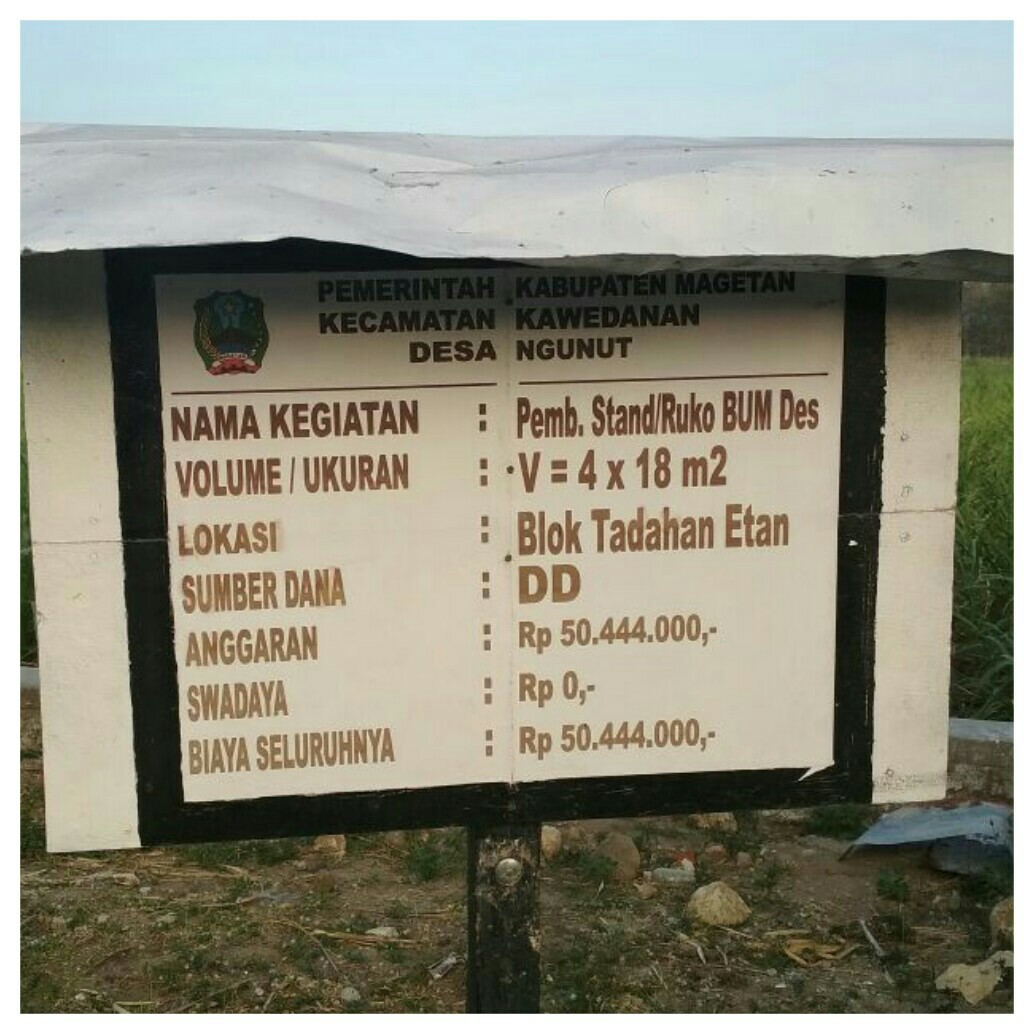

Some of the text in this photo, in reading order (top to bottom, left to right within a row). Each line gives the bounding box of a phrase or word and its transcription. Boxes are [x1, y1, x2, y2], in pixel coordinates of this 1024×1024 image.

[318, 271, 796, 302] PEMERINTAH KABUPATEN MAGETAN
[319, 303, 700, 334] KECAMATAN KAWEDANAN
[409, 337, 633, 363] DESA NGUNUT
[170, 404, 261, 441] NAMA
[269, 400, 419, 439] KEGIATAN
[517, 396, 584, 439] Pemb.
[592, 393, 716, 437] Stand/Ruko
[722, 390, 773, 432] BUM
[779, 389, 819, 430] Des
[175, 457, 282, 498] VOLUME
[289, 457, 296, 494] /
[303, 453, 409, 493] UKURAN
[518, 452, 541, 493] V
[551, 460, 568, 483] =
[578, 450, 597, 490] 4
[606, 459, 625, 490] x
[636, 447, 671, 489] 18
[682, 445, 727, 487] m2
[177, 521, 279, 557] LOKASI
[517, 510, 583, 556] Blok
[590, 507, 714, 553] Tadahan
[725, 503, 789, 548] Etan
[181, 571, 278, 614] SUMBER
[284, 567, 346, 608] DANA
[518, 564, 582, 604] DD
[185, 626, 318, 667] ANGGARAN
[518, 621, 552, 654] Rp
[560, 614, 717, 647] 50.444.000,-
[187, 680, 289, 722] SWADAYA
[518, 672, 554, 708] Rp
[563, 671, 595, 705] 0,-
[188, 737, 251, 775] BIAYA
[256, 728, 396, 771] SELURUHNYA
[518, 726, 552, 760] Rp
[560, 718, 716, 752] 50.444.000,-
